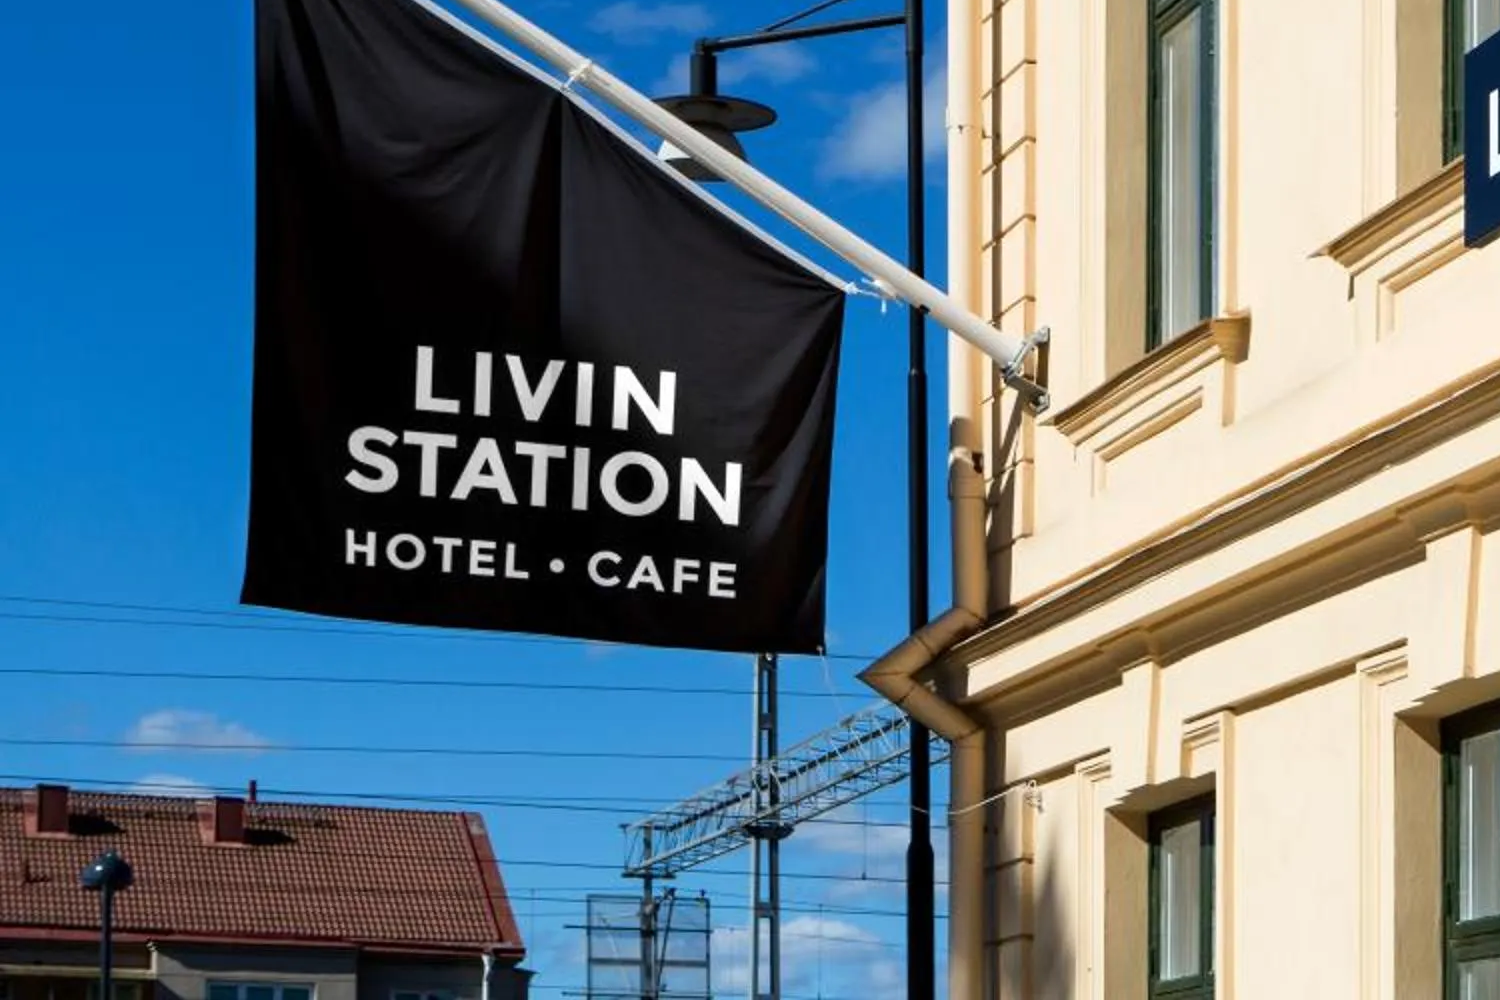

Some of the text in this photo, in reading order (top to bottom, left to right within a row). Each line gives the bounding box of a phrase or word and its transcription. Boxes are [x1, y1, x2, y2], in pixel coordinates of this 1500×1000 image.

[415, 345, 677, 436] LIVIN
[344, 426, 743, 527] STATION
[345, 528, 737, 599] HOTEL CAFE
